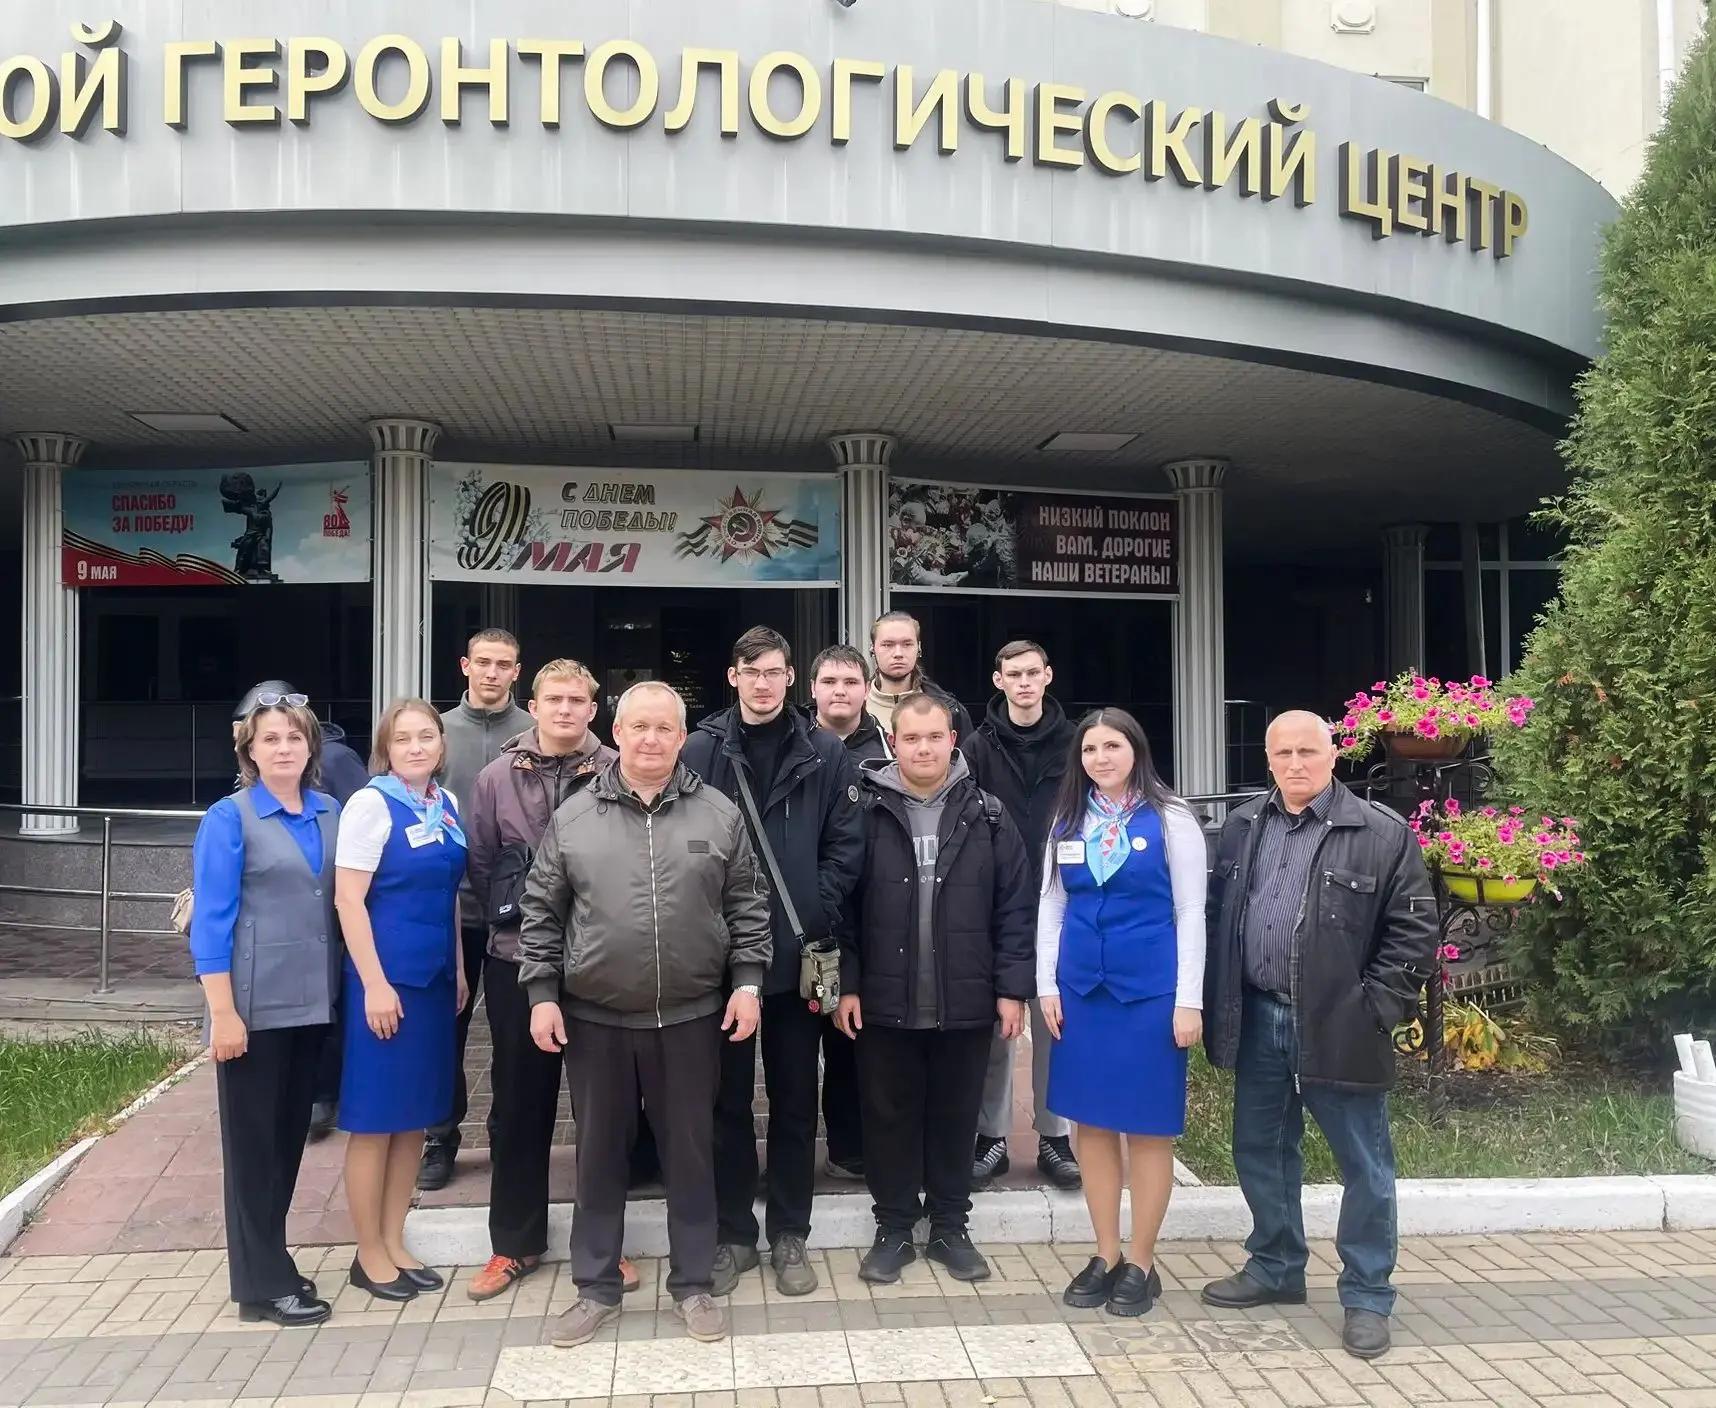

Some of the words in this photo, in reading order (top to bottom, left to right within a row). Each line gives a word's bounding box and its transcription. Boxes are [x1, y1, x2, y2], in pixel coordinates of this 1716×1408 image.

[164, 33, 1316, 208] ГЕРОНТОЛОГИЧЕСКИЙ
[1338, 140, 1529, 260] ЦЕНТР
[111, 494, 176, 511] СПАСИБО
[561, 482, 578, 503] С
[583, 482, 657, 505] ДНЕМ
[112, 515, 131, 533] ЗА
[134, 514, 194, 534] ПОБЕДУ!
[323, 514, 338, 529] 80
[560, 509, 678, 533] ПОБЕДЫ!
[1039, 505, 1104, 530] НИЗКИЙ
[1109, 509, 1171, 532] ПОКЛОН
[509, 541, 642, 573] МАЯ
[1056, 534, 1098, 557] ВАМ,
[1102, 535, 1171, 560] ДОРОГИЕ
[77, 560, 87, 581] 9
[90, 566, 117, 580] МАЯ
[1031, 560, 1080, 583] НАШИ
[1084, 562, 1171, 586] ВЕТЕРАНЫ!
